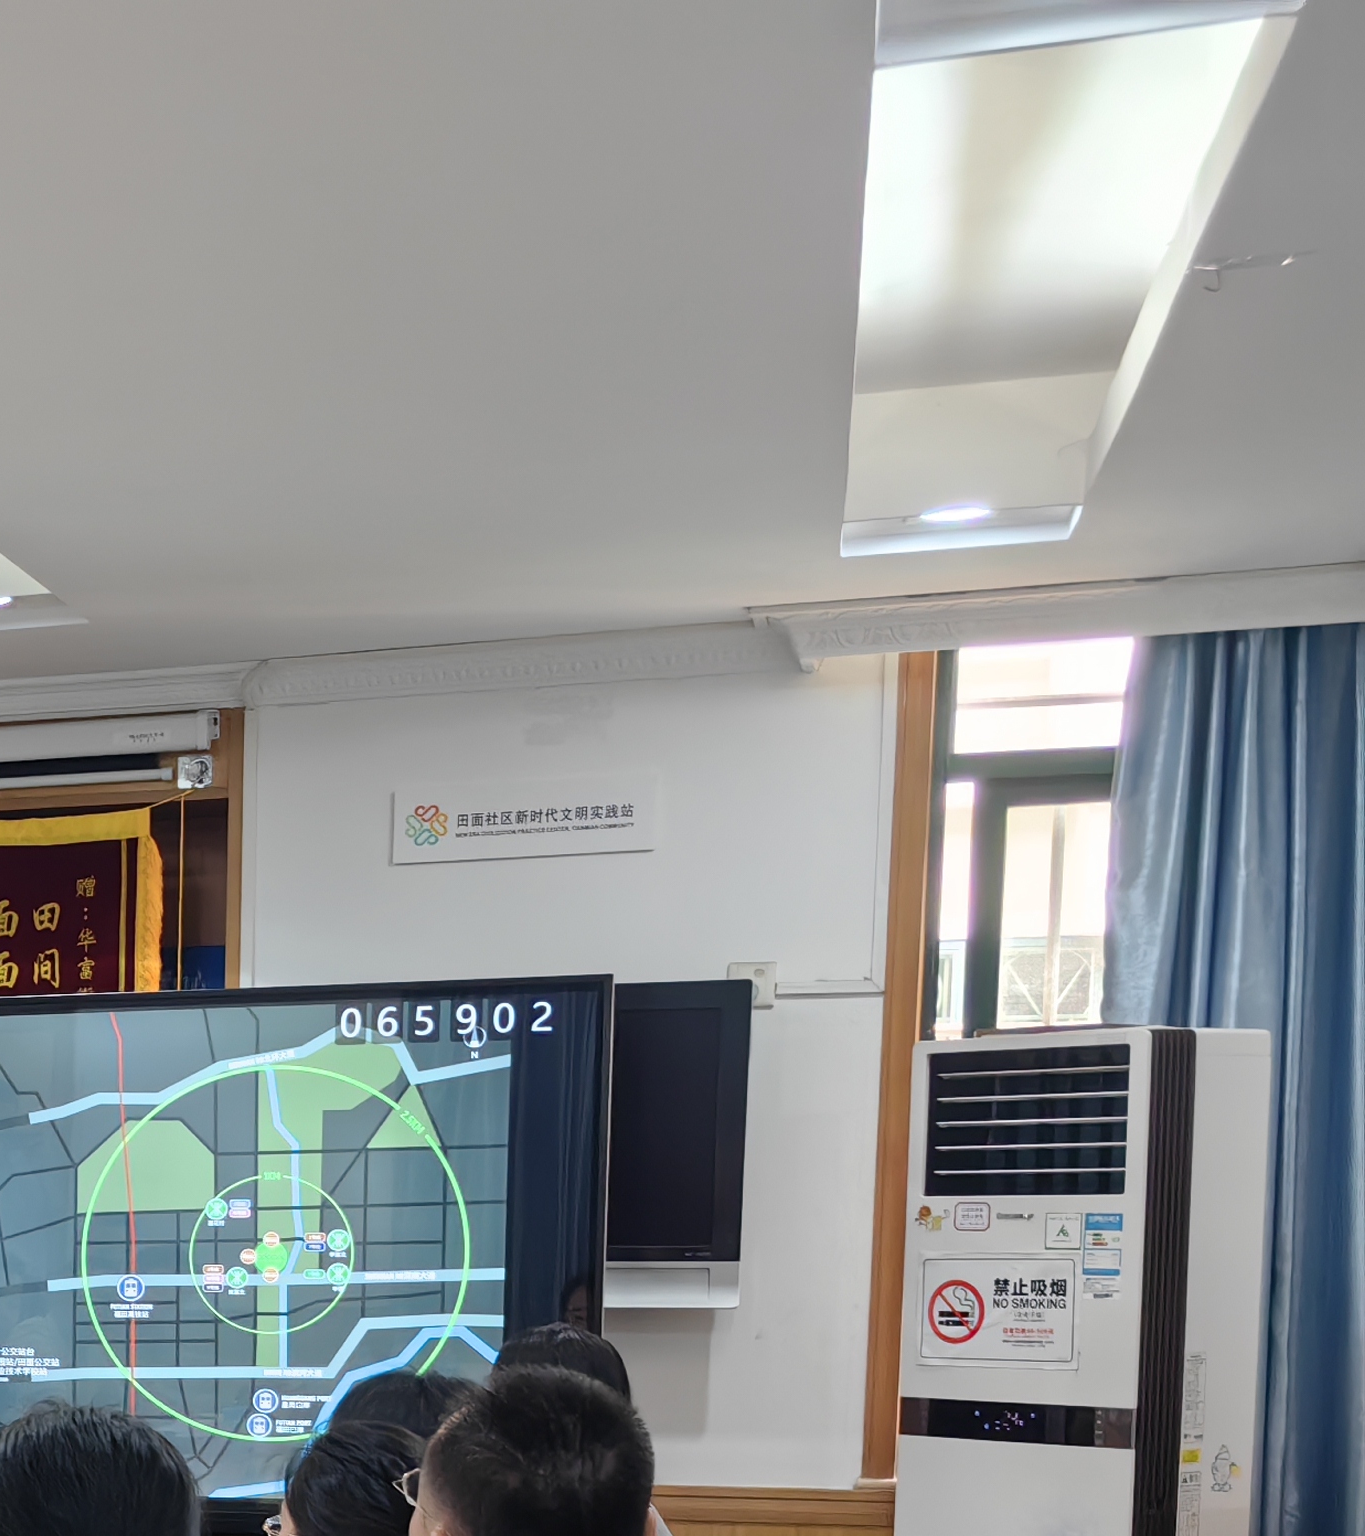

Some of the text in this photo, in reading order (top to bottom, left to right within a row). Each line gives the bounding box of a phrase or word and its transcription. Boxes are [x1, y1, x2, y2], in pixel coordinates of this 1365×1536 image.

[456, 803, 635, 828] 田面社区新时代文明实践站
[993, 1277, 1067, 1297] 禁止吸烟
[993, 1298, 1067, 1309] NO SMOKING
